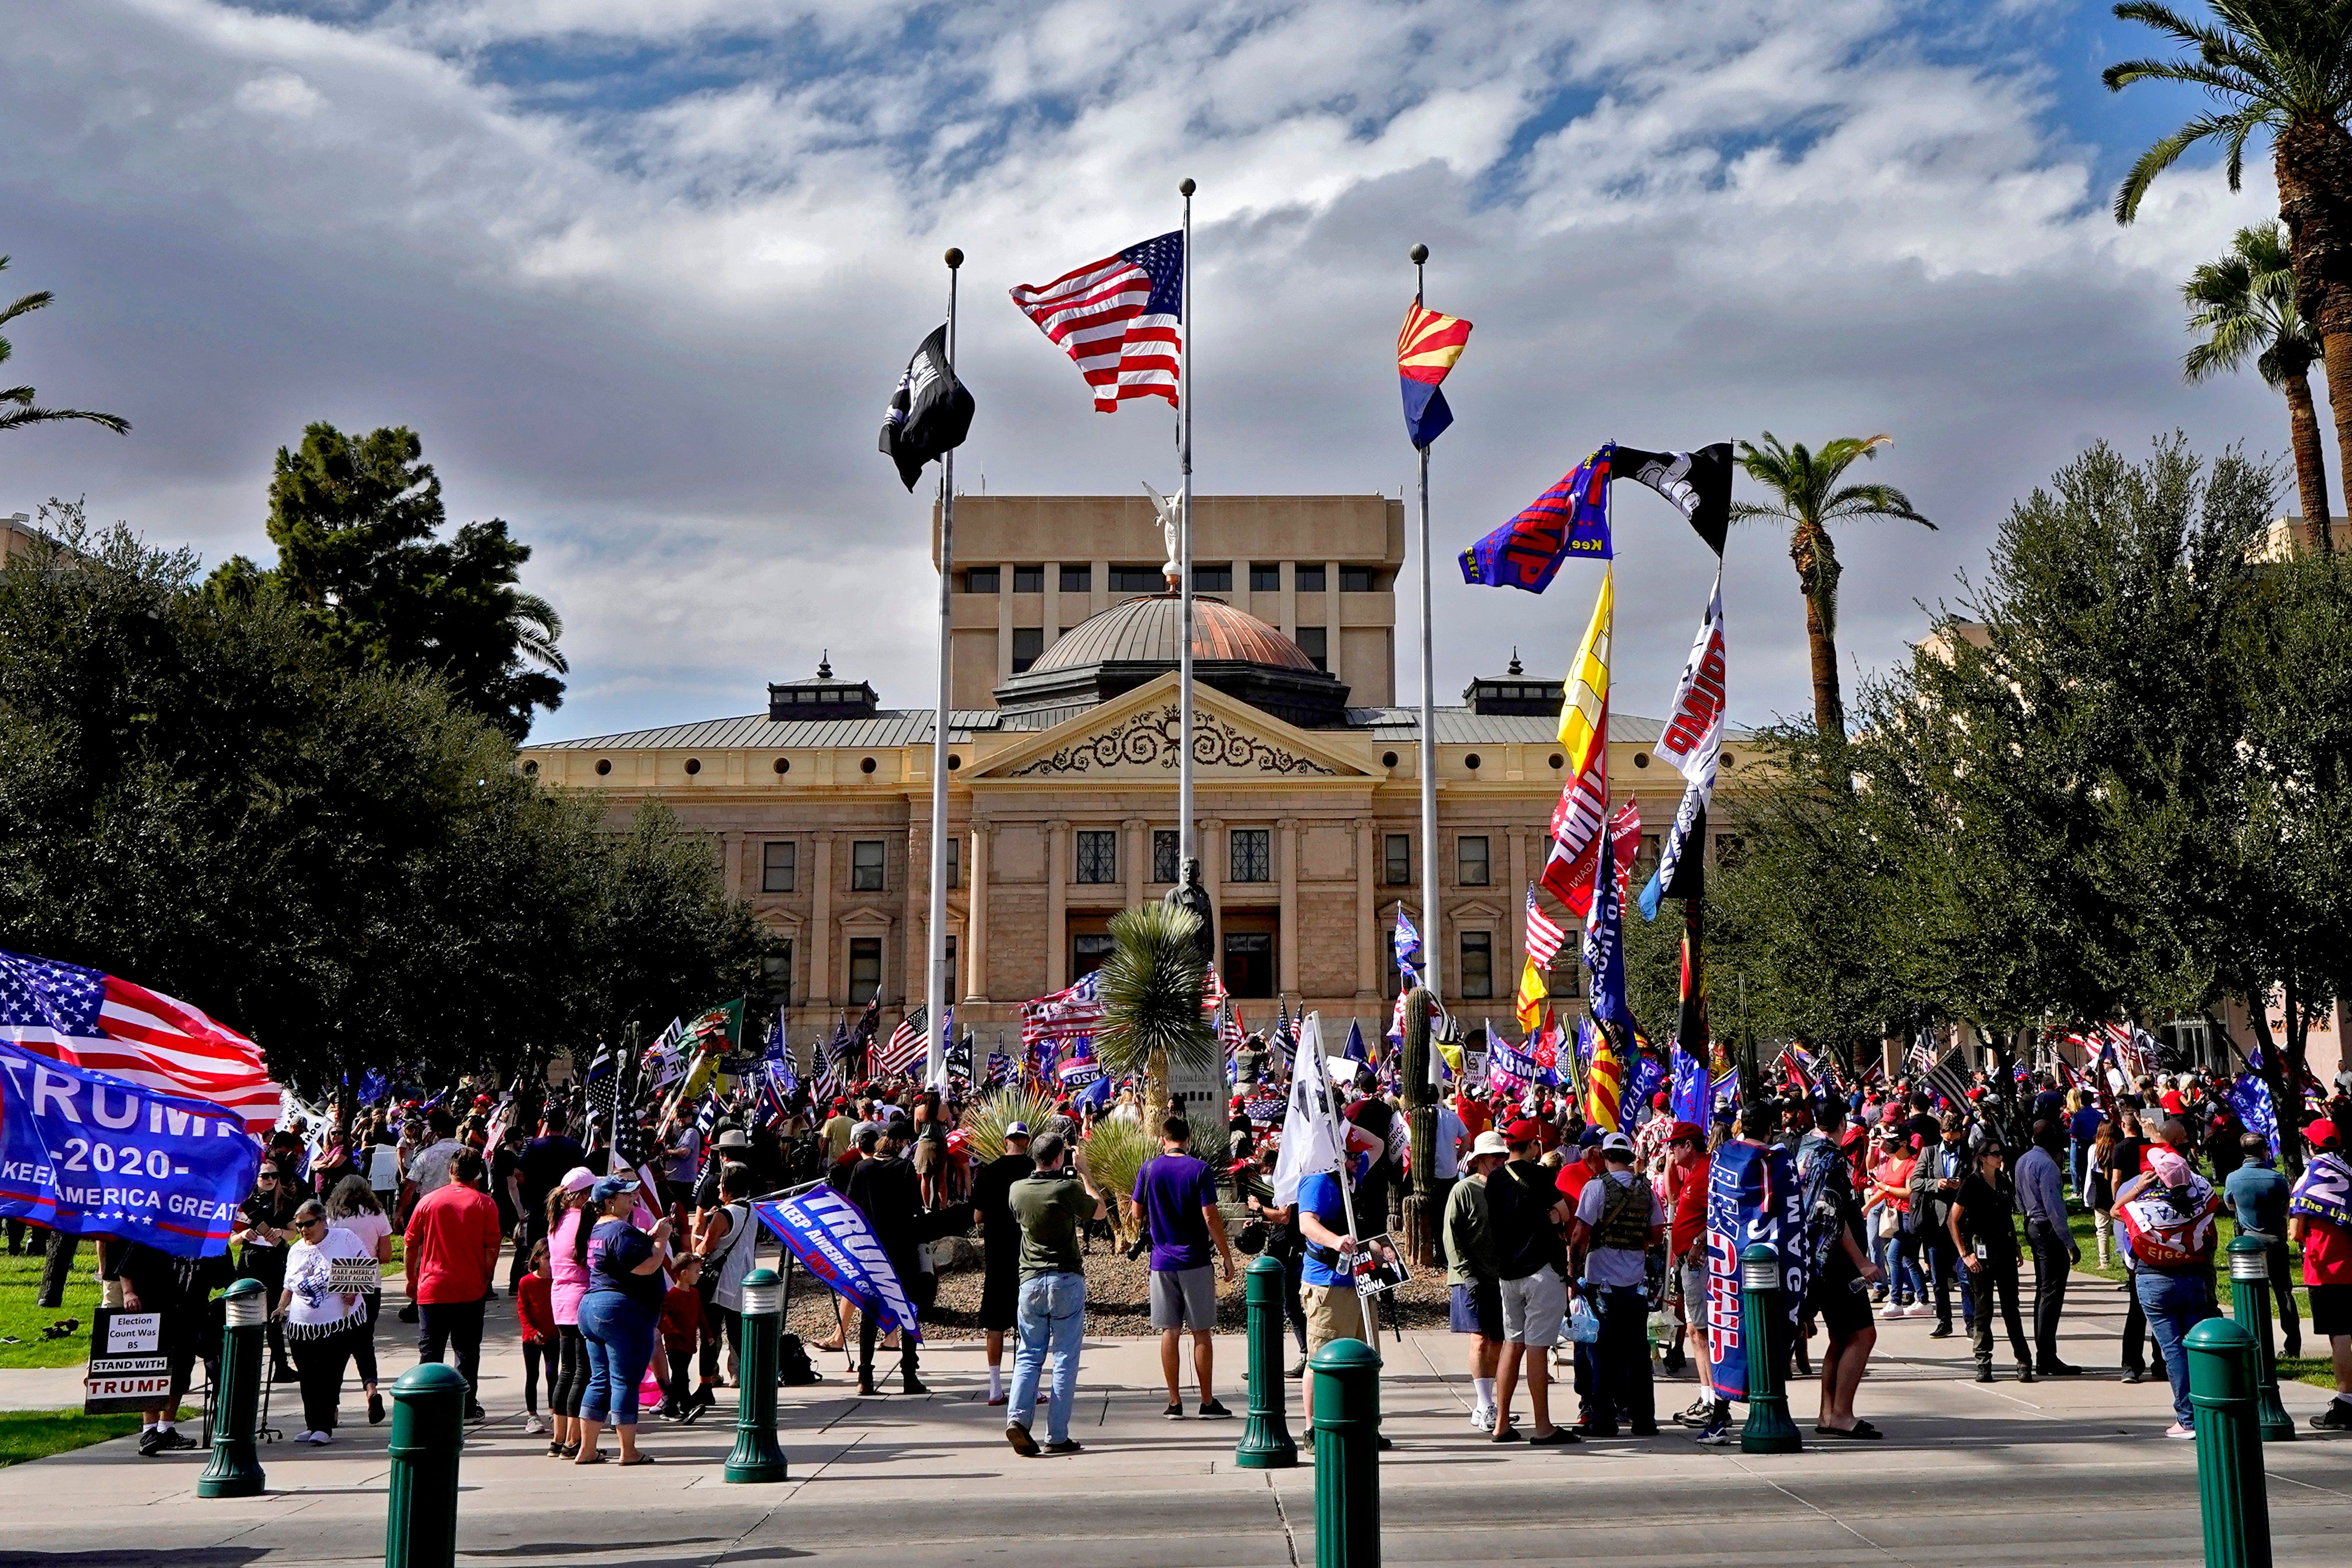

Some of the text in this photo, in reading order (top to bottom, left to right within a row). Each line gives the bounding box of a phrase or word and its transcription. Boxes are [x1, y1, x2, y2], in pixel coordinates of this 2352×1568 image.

[2300, 1197, 2323, 1213] The
[775, 1198, 861, 1279] KEEP AMERICA
[803, 1191, 916, 1331] TRUMP
[804, 1250, 838, 1281] 2020
[1358, 1278, 1386, 1296] CHINA
[118, 1316, 152, 1326] Election
[109, 1328, 157, 1338] Count Was
[127, 1341, 139, 1349] BS
[93, 1360, 165, 1371] STAND WITH
[89, 1379, 169, 1395] TRUMP
